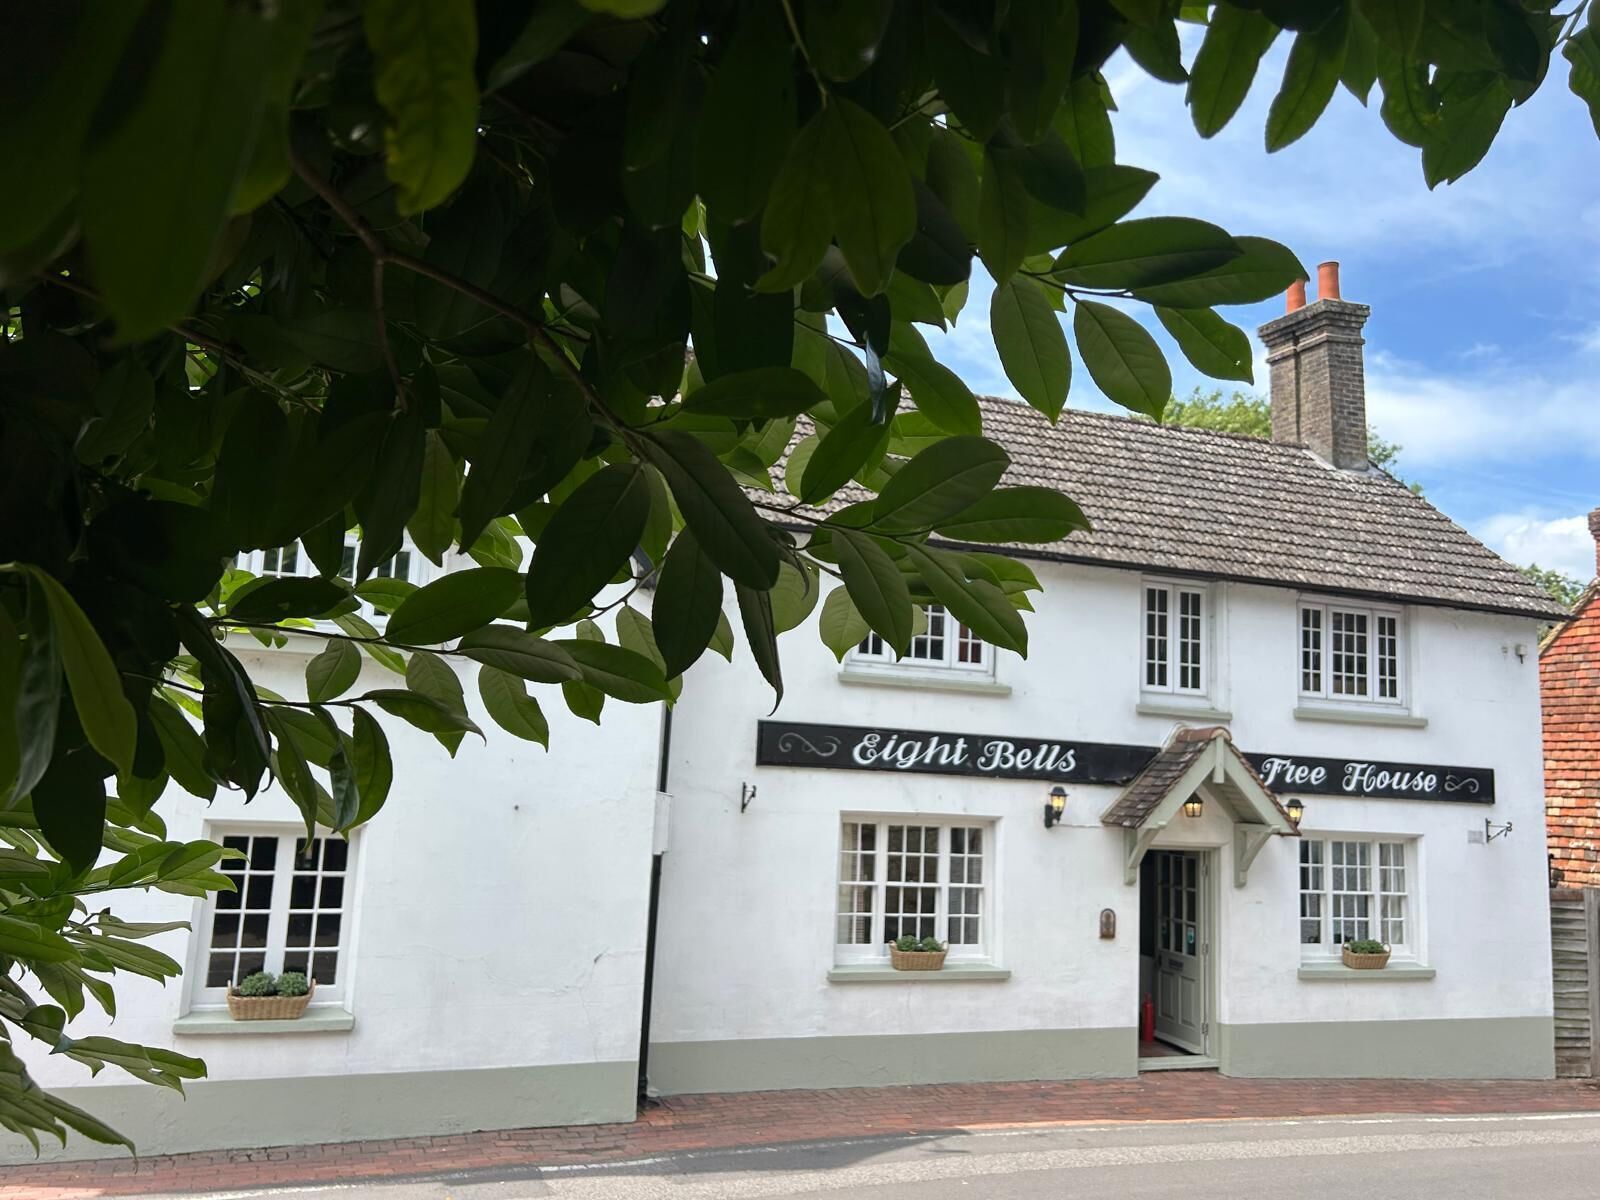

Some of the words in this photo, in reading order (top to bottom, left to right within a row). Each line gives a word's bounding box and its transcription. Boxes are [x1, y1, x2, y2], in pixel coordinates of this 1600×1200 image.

[851, 733, 969, 769] Eight
[977, 740, 1077, 772] Bells
[1260, 757, 1327, 786] Free
[1342, 762, 1437, 792] House
